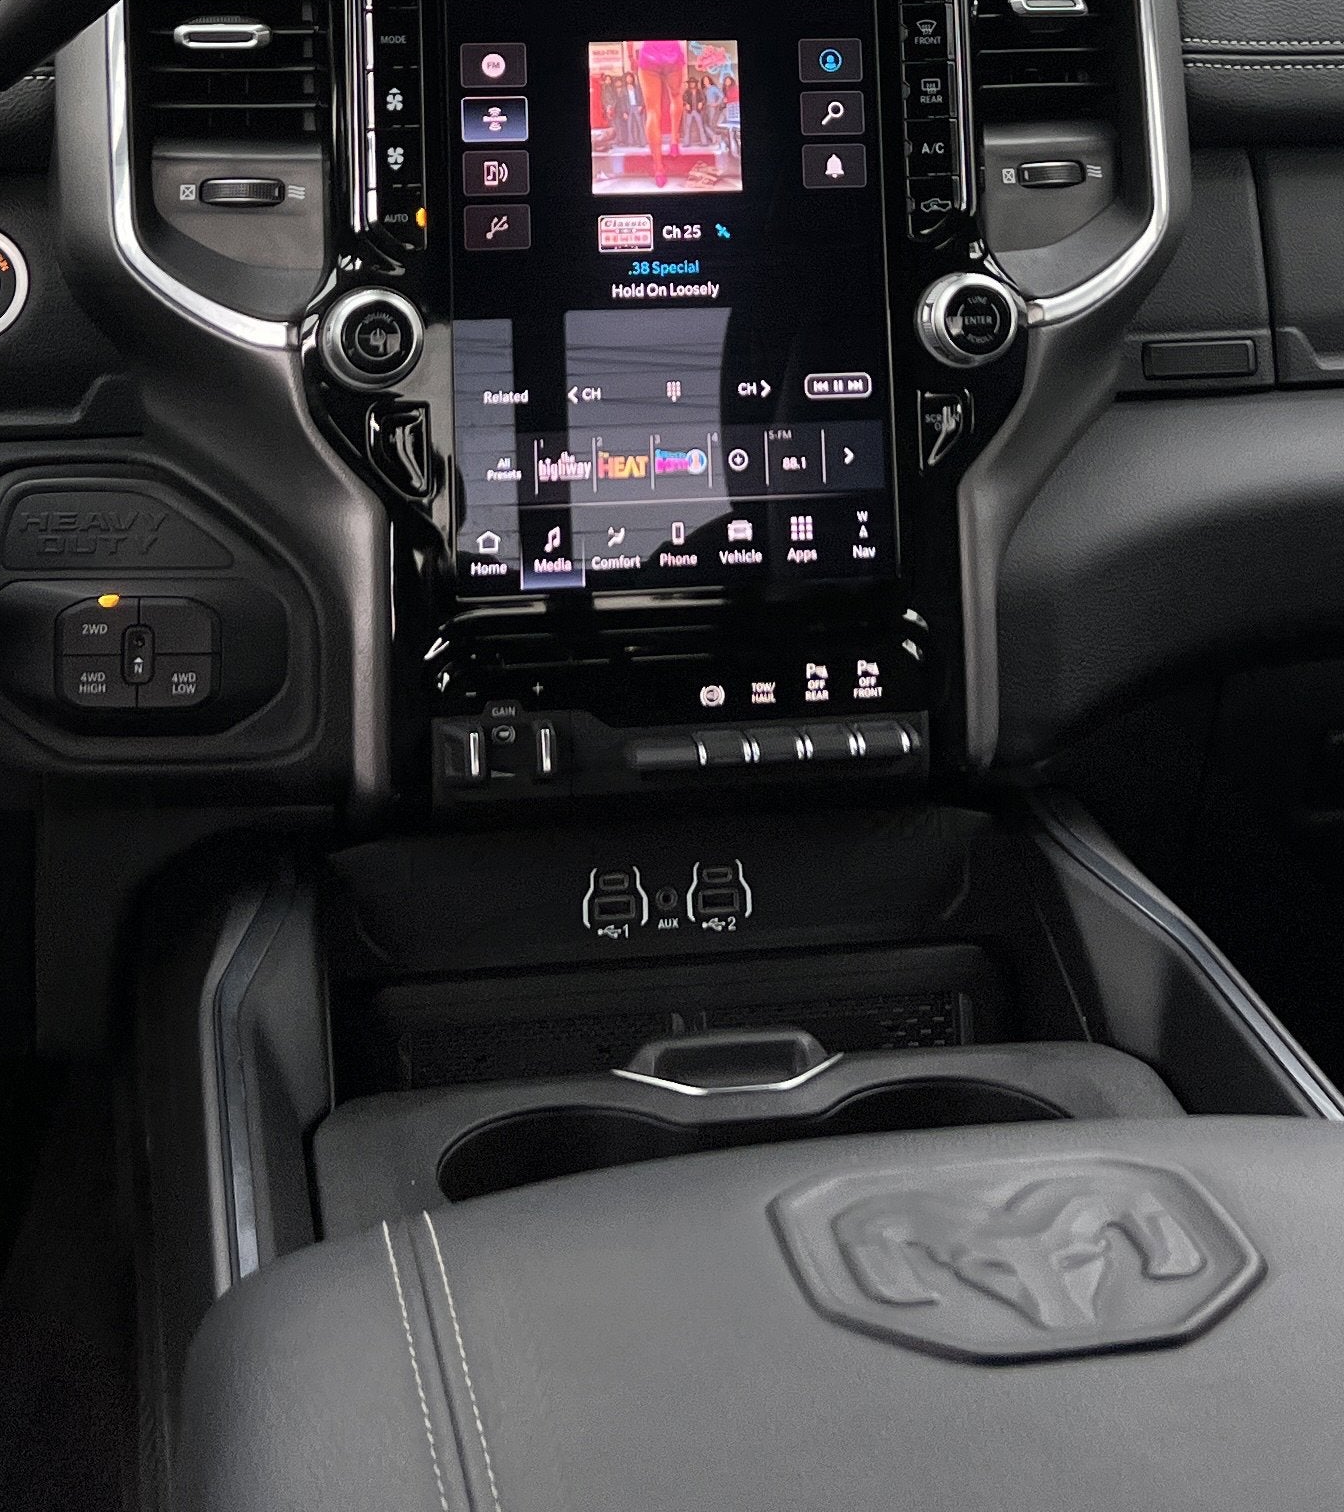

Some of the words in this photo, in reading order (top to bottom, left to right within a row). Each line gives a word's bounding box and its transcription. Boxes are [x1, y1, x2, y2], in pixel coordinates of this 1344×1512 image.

[380, 34, 407, 44] MODE
[914, 36, 942, 45] FRONT
[486, 61, 501, 69] FM
[919, 95, 943, 104] REAR
[921, 142, 944, 154] A/C
[384, 213, 409, 224] AUTO
[662, 224, 682, 239] Ch
[683, 224, 702, 239] 25
[628, 260, 650, 276] .38
[651, 259, 700, 277] Special
[611, 282, 644, 298] Hold
[646, 282, 667, 298] On
[669, 280, 720, 299] Loosely
[964, 315, 993, 325] ENTER
[582, 387, 602, 402] CH
[737, 381, 757, 396] CH
[483, 389, 529, 404] Related
[496, 456, 511, 468] All
[597, 455, 649, 479] HEAT
[486, 468, 522, 482] Presets
[538, 457, 592, 482] highway
[19, 511, 169, 533] HEAVY
[37, 534, 160, 556] DUTY
[718, 549, 763, 565] Vehicle
[787, 546, 818, 563] Apps
[852, 545, 876, 559] Nav
[533, 557, 572, 572] Media
[591, 554, 641, 570] Comfort
[659, 551, 698, 567] Phone
[470, 561, 508, 576] Home
[81, 623, 109, 635] 2WD
[133, 663, 143, 674] N
[80, 671, 106, 682] 4WD
[171, 671, 197, 682] 4WD
[858, 676, 876, 687] OFF
[78, 683, 106, 694] HIGH
[172, 683, 197, 695] LOW
[807, 679, 826, 690] OFF
[751, 692, 776, 704] HAUL
[805, 689, 829, 701] REAR
[853, 686, 883, 698] FRONT
[492, 705, 516, 717] GAIN
[657, 917, 680, 929] AUX
[727, 916, 737, 931] 2
